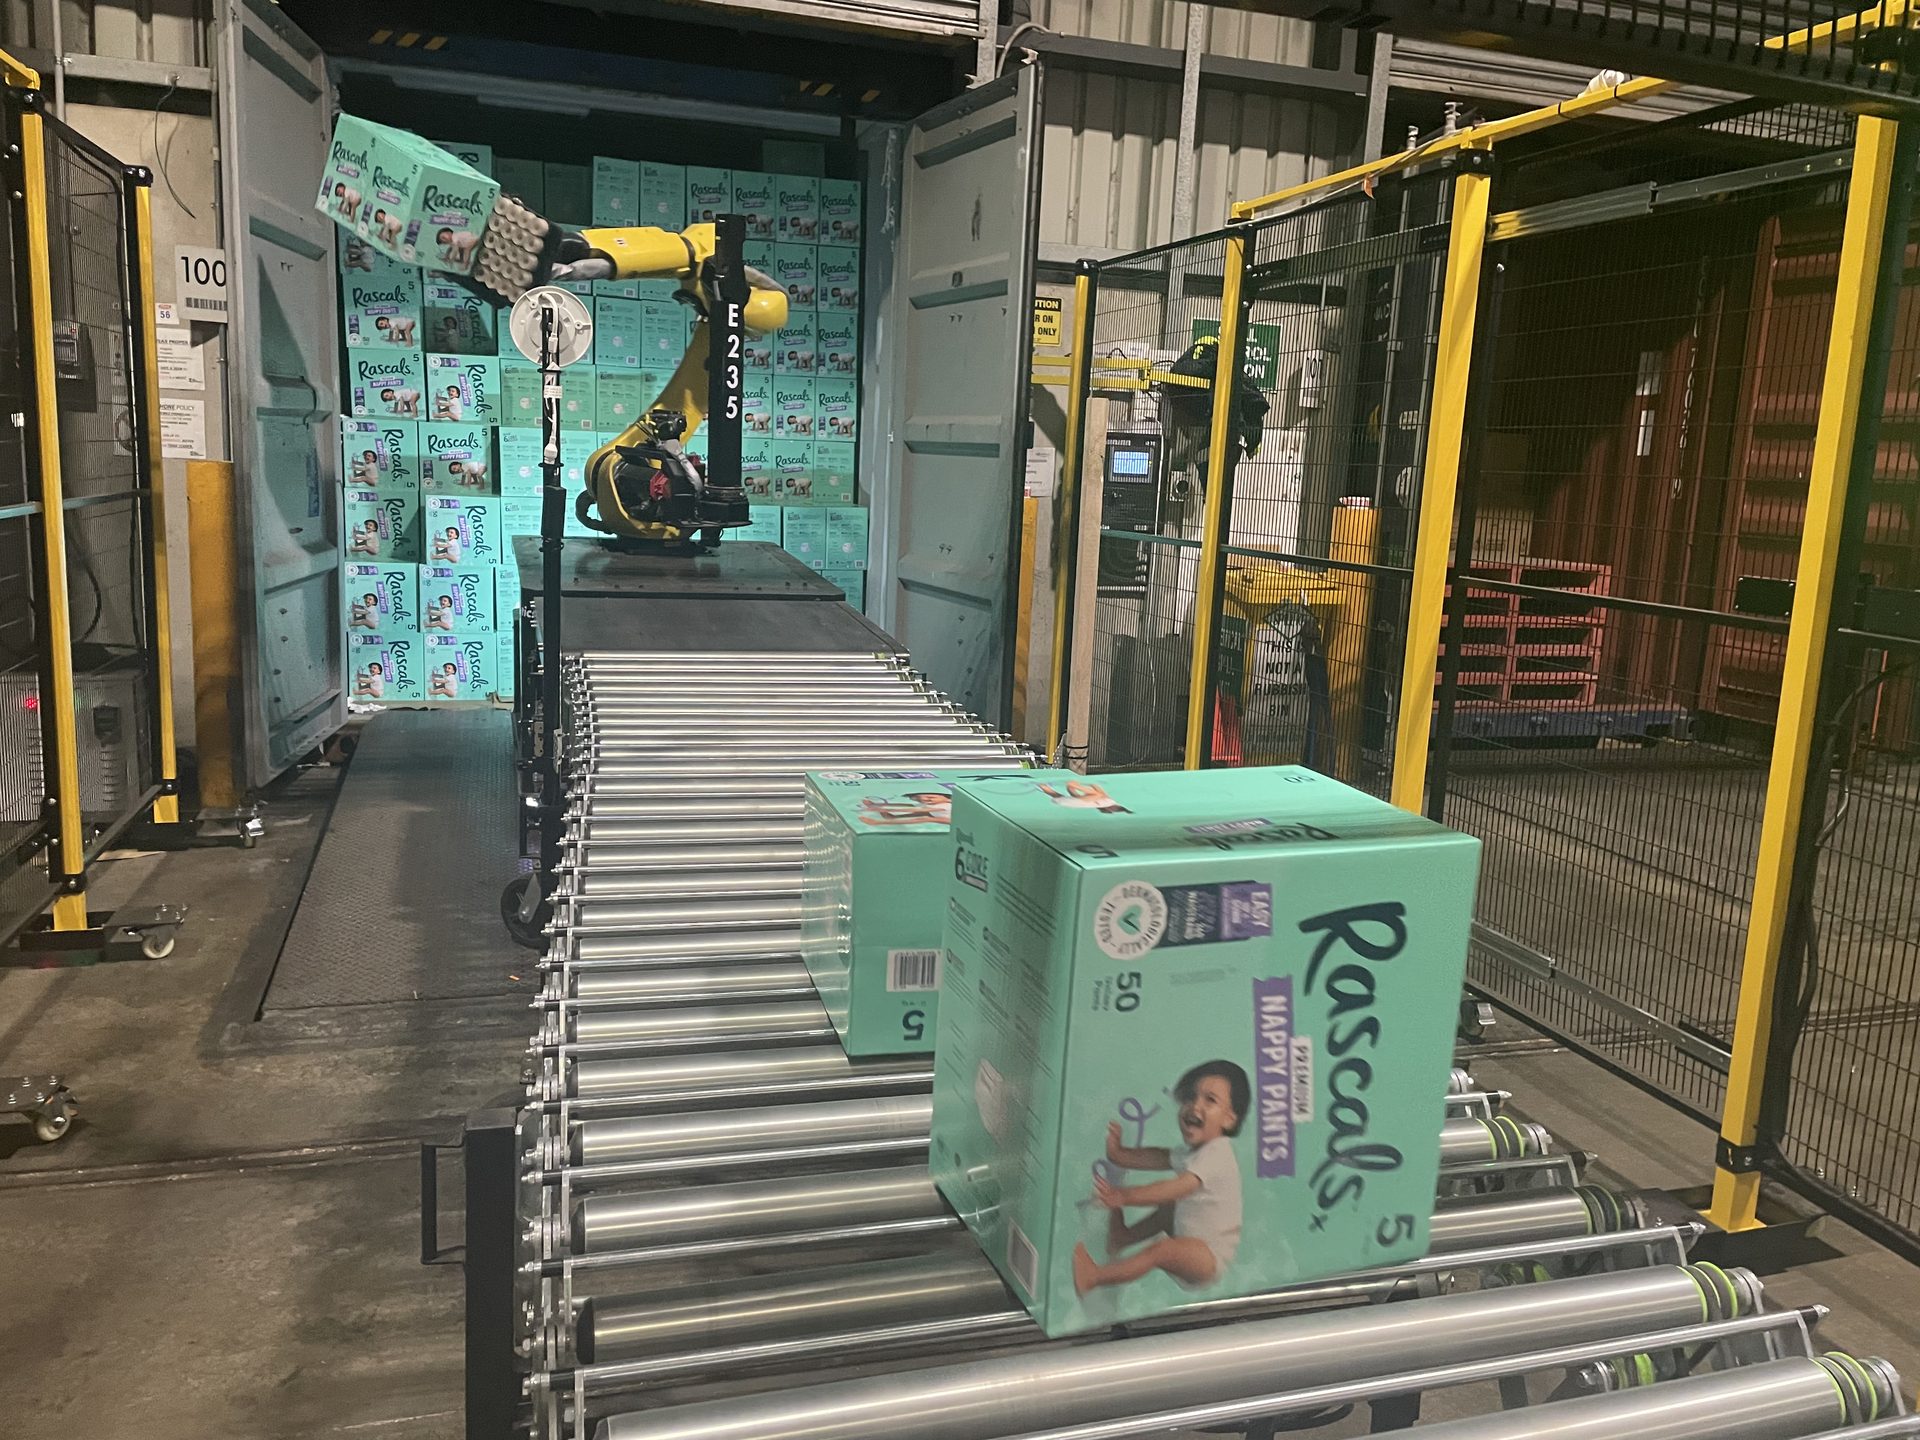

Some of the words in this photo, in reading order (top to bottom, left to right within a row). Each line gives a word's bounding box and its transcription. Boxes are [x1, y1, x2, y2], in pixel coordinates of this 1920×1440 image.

[421, 185, 484, 215] Rascals
[487, 187, 495, 198] 5
[352, 285, 408, 308] Rascals
[408, 281, 415, 290] 5
[160, 311, 171, 319] 56
[1042, 315, 1054, 323] ON
[1037, 327, 1057, 336] ONLY
[358, 357, 412, 381] Rascals
[465, 364, 493, 415] Rascals
[428, 432, 480, 454] Rascals
[481, 428, 488, 436] 5
[382, 429, 410, 480] Rascals
[465, 506, 493, 556] Rascals
[383, 571, 411, 622] Rascals
[458, 574, 485, 624] Rascals
[388, 640, 416, 690] Rascals
[462, 641, 489, 690] Rascals
[1266, 662, 1290, 674] NOT
[1255, 683, 1306, 695] RUBBISH
[1270, 704, 1289, 716] BIN
[1251, 891, 1271, 928] EASY
[1115, 971, 1142, 1012] 50
[902, 1009, 925, 1041] 5
[1261, 994, 1288, 1075] NAPPY
[1298, 901, 1408, 1210] Rascals
[1261, 1083, 1289, 1162] PANTS
[1376, 1213, 1414, 1247] 5
